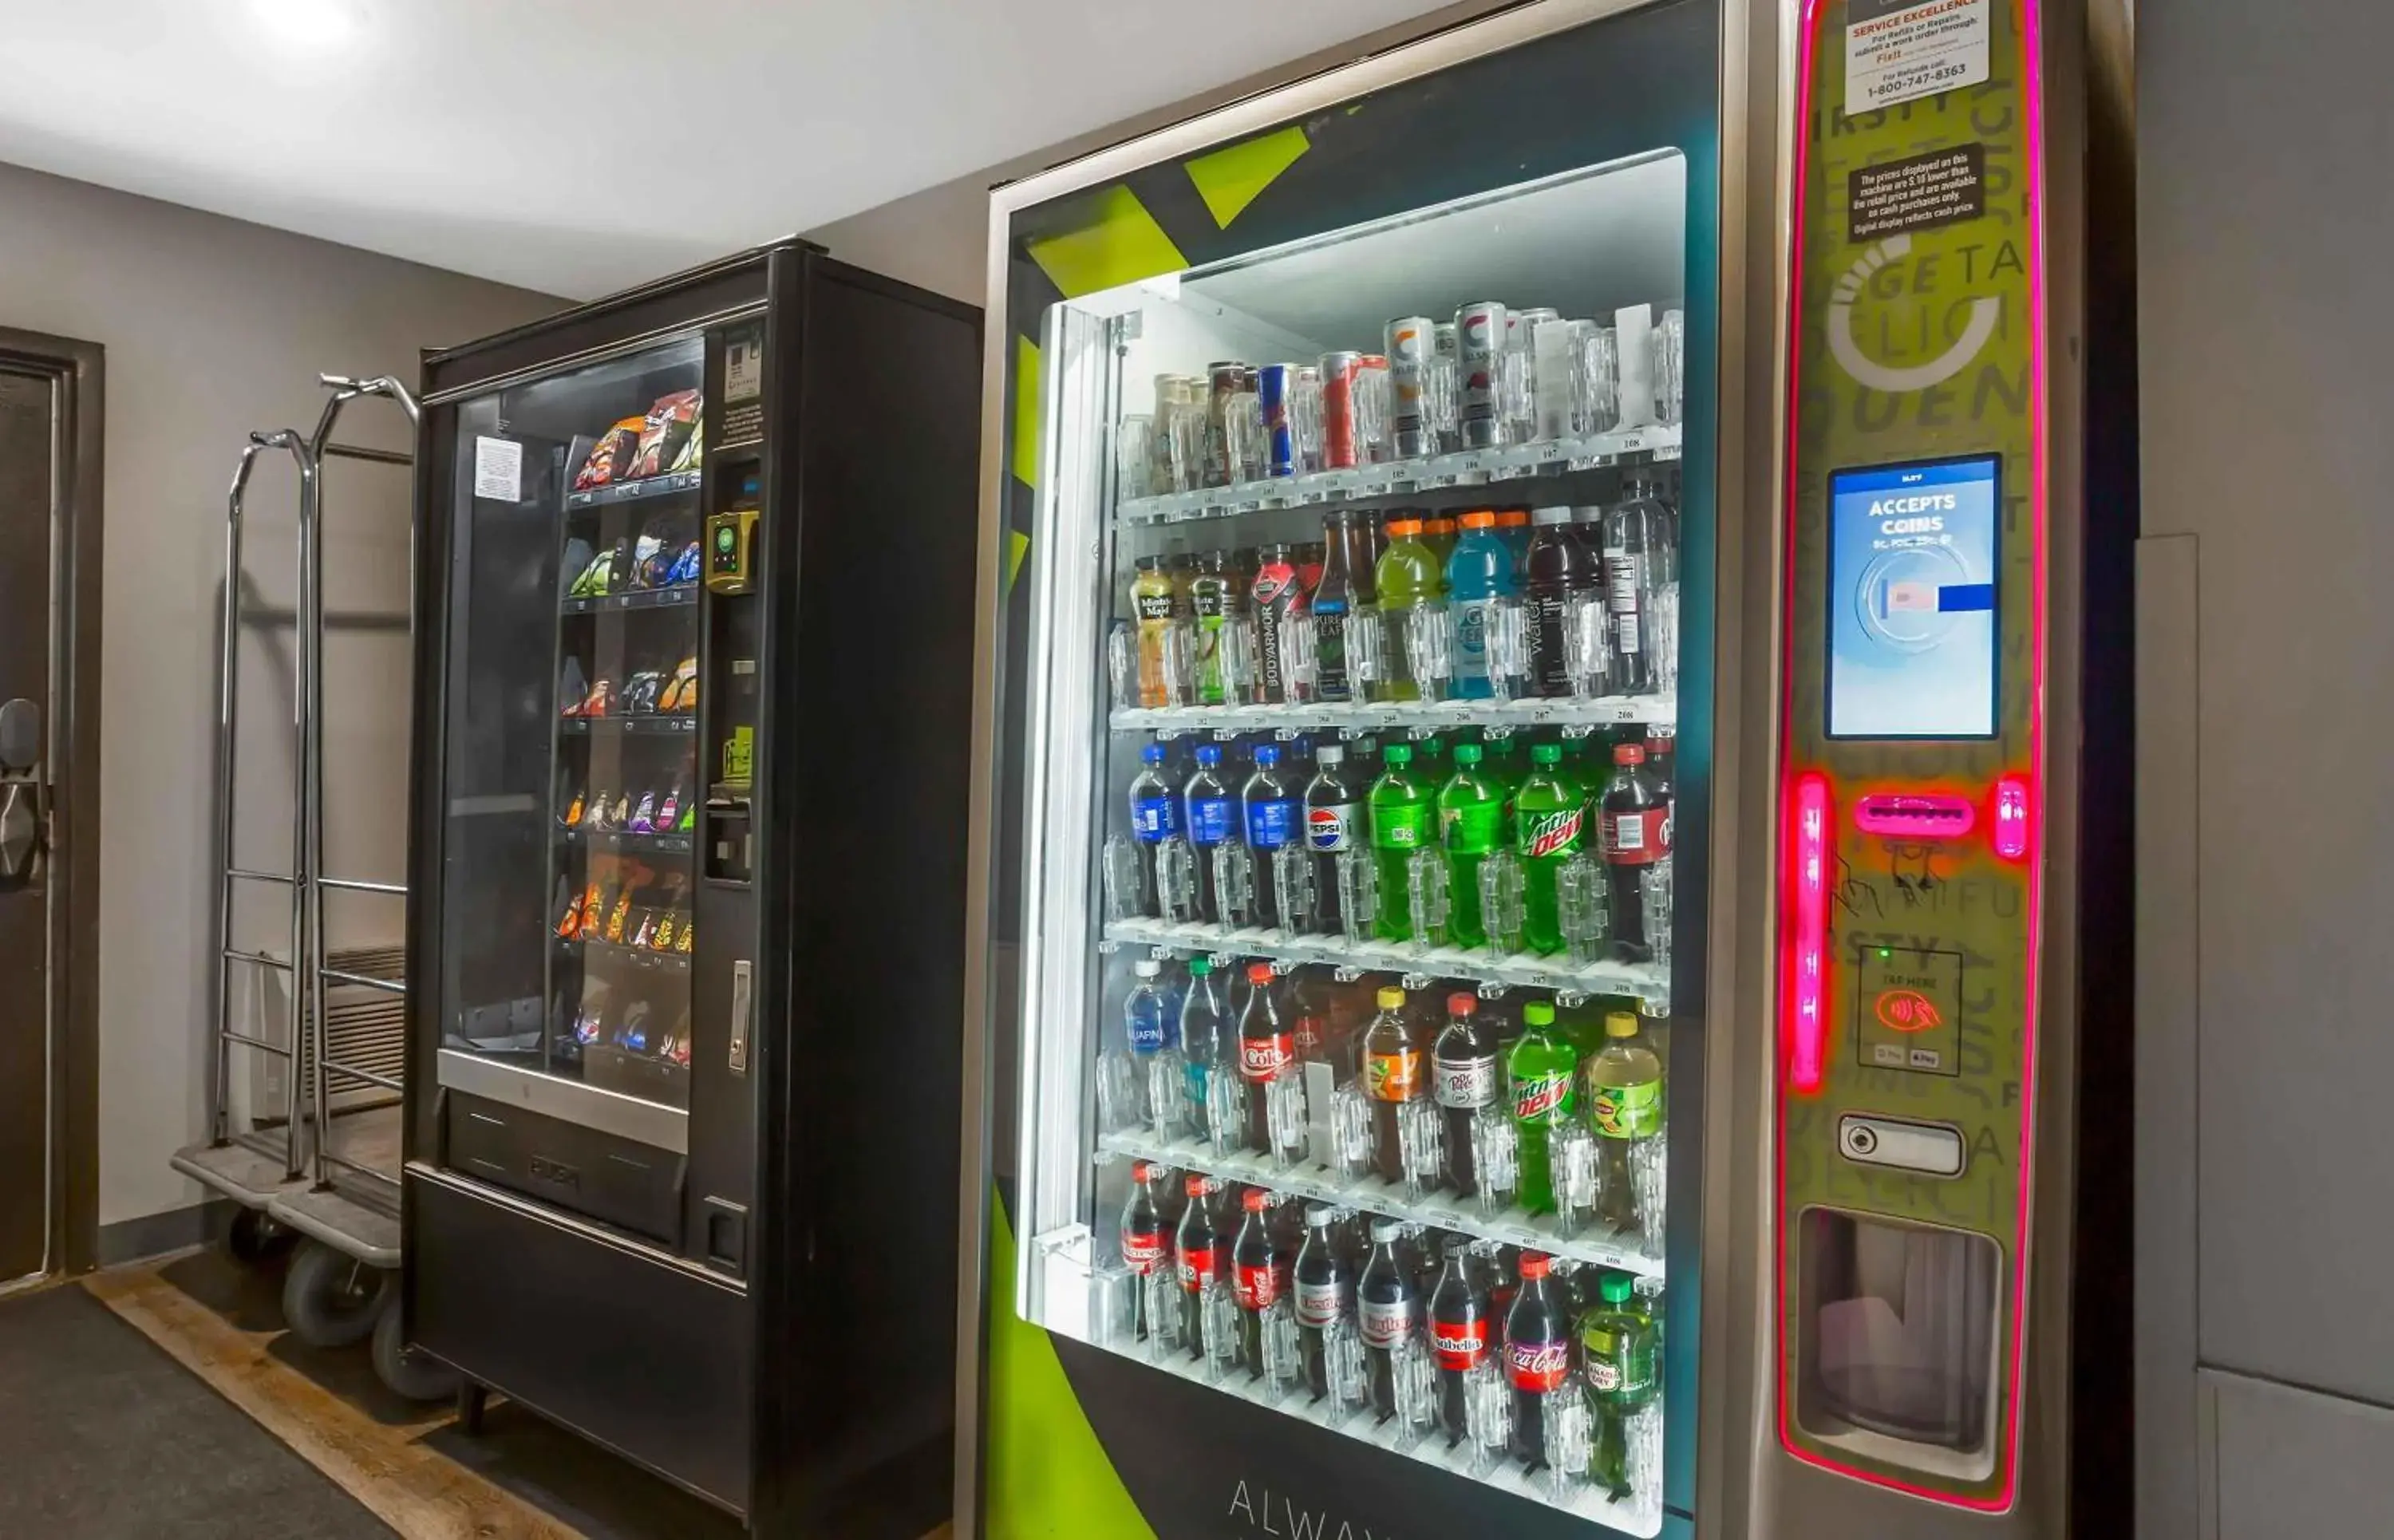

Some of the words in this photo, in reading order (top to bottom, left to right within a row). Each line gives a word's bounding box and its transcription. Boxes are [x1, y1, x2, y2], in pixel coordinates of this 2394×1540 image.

[1853, 16, 1902, 38] SERVICE
[1903, 0, 1979, 22] EXCELLENC
[1927, 14, 1961, 29] Repairs
[1892, 35, 1913, 47] work
[1915, 29, 1938, 40] order
[1867, 64, 1966, 97] 1-800-747-8363
[1861, 175, 1875, 185] The
[1876, 169, 1901, 184] prices
[1902, 160, 1940, 176] displayed
[1894, 180, 1908, 190] are
[1927, 170, 1950, 183] lower
[1867, 194, 1887, 207] retail
[1888, 192, 1908, 205] price
[1926, 184, 1940, 194] are
[1940, 176, 1977, 191] available
[1879, 203, 1898, 215] cash
[1899, 195, 1940, 214] purchases
[1878, 217, 1903, 231] display
[1934, 206, 1953, 218] cash
[1868, 495, 1955, 516] ACCEPTS
[1882, 516, 1944, 535] COINS
[1262, 606, 1278, 687] BODYARMOR
[1883, 974, 1905, 985] TAP
[1906, 977, 1938, 989] HERE
